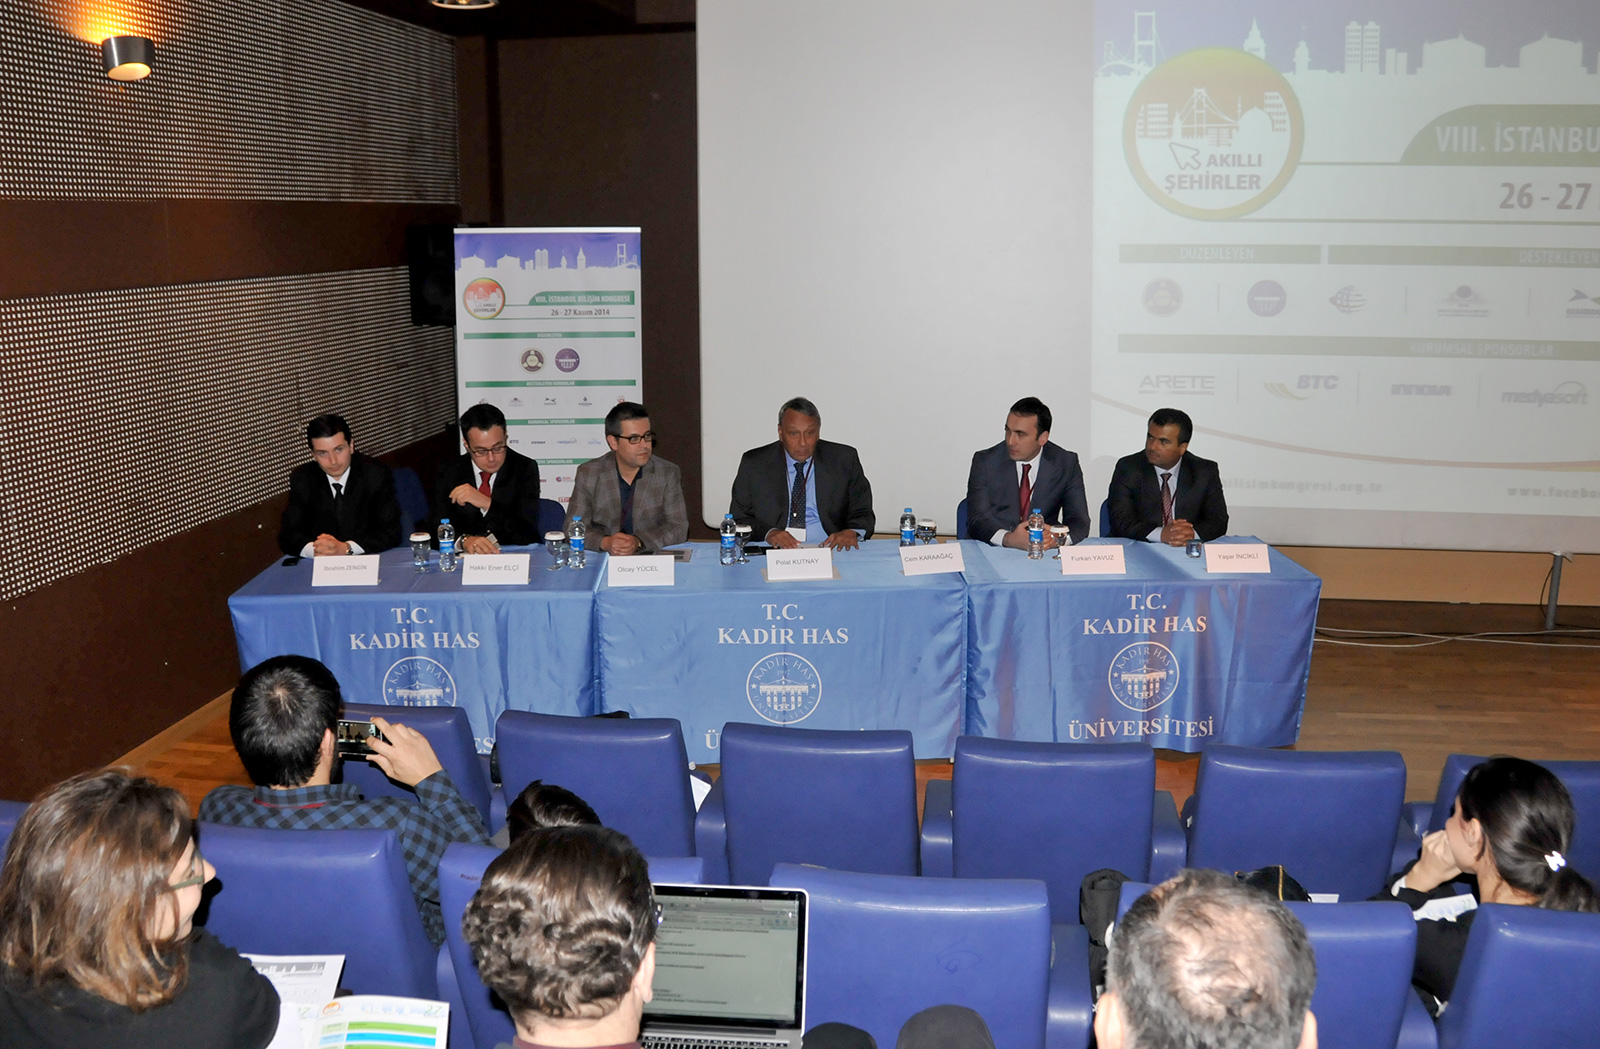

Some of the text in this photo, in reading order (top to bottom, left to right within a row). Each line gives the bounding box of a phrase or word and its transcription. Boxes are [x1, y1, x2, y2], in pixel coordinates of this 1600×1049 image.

[1436, 126, 1486, 152] VIII.
[1206, 154, 1262, 167] AKILLI
[1165, 170, 1261, 194] ŞEHİRLER
[1499, 182, 1533, 209] 26
[1557, 182, 1592, 210] 27
[594, 308, 610, 316] 2014
[1410, 342, 1554, 358] KURUMSAL SPONSORLAR
[1138, 375, 1215, 389] ARETE
[1297, 375, 1339, 390] BTC
[636, 564, 659, 572] YÜCEL
[1126, 593, 1167, 610] T.C.
[391, 607, 434, 624] T.C.
[762, 603, 804, 620] T.C.
[1082, 614, 1207, 635] KADİR HAS
[349, 628, 480, 650] KADİR HAS
[717, 625, 849, 644] KADİR HAS
[1153, 648, 1171, 667] HAS
[426, 663, 447, 684] HAS
[793, 660, 814, 680] HAS
[1068, 714, 1214, 740] ÜNİVERSİTESİ
